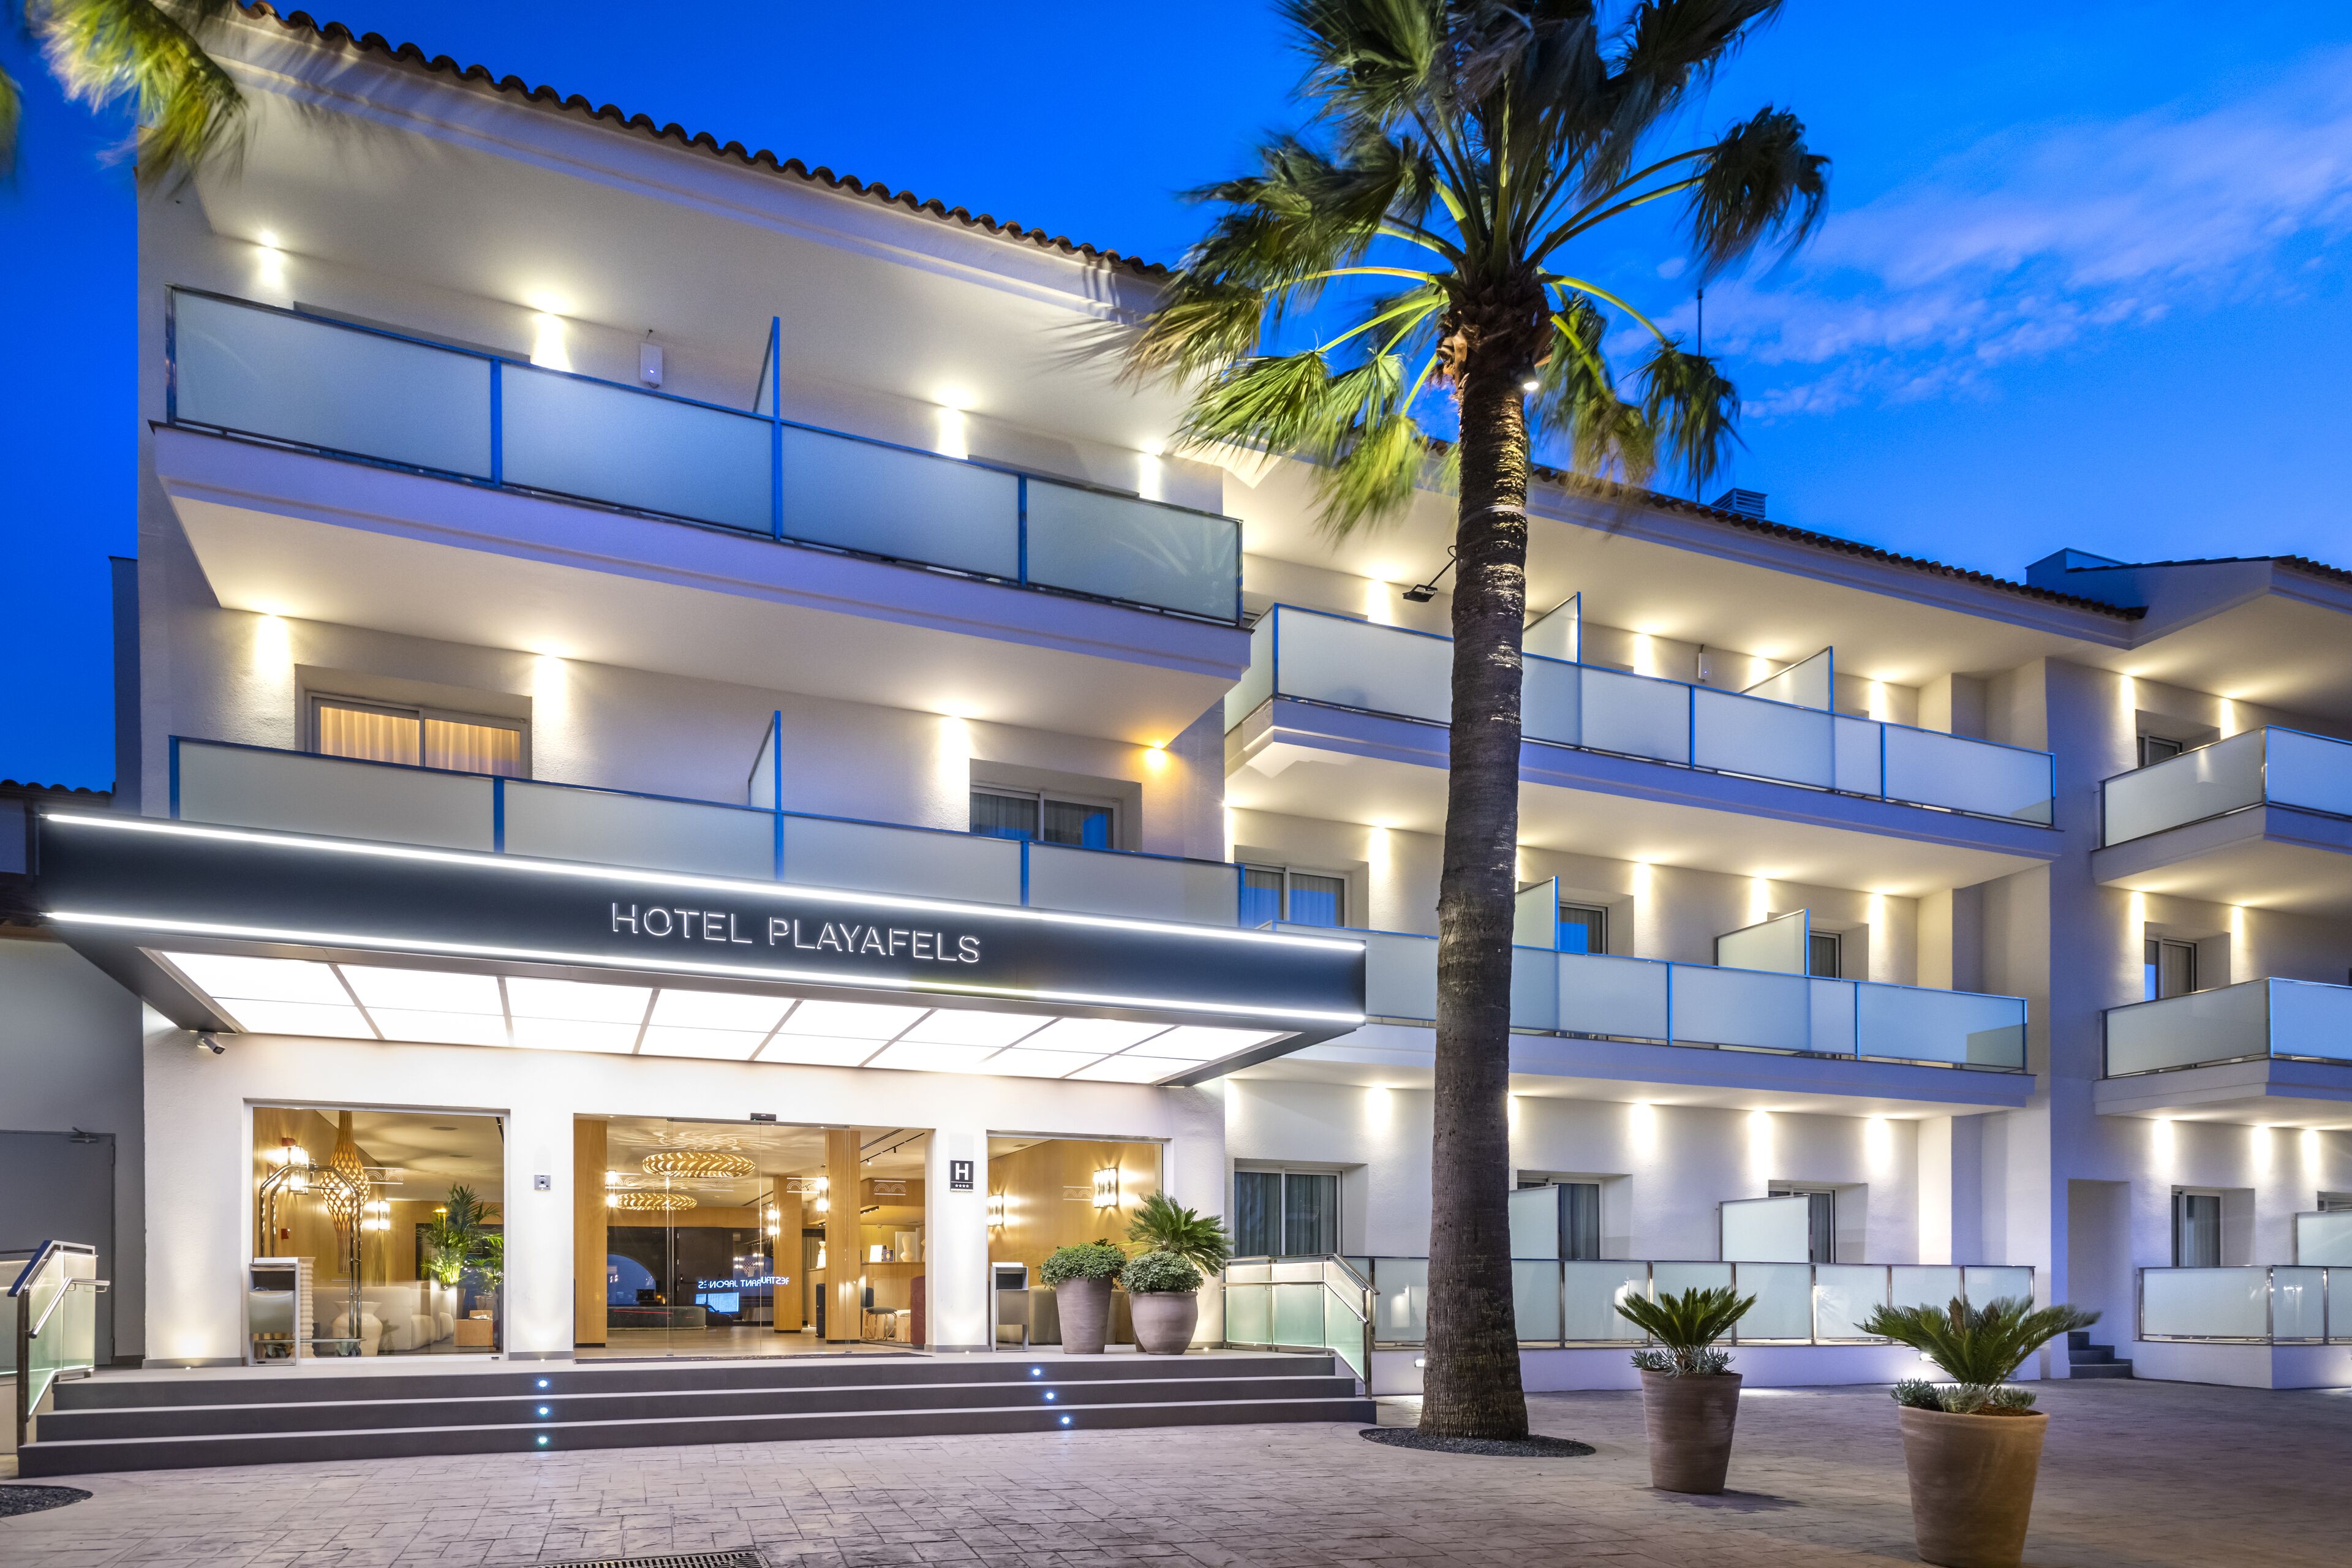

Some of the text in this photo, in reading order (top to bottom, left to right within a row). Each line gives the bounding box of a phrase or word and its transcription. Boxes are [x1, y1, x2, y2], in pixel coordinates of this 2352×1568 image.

[612, 902, 981, 963] HOTEL PLAYAFELS
[956, 1163, 969, 1180] H
